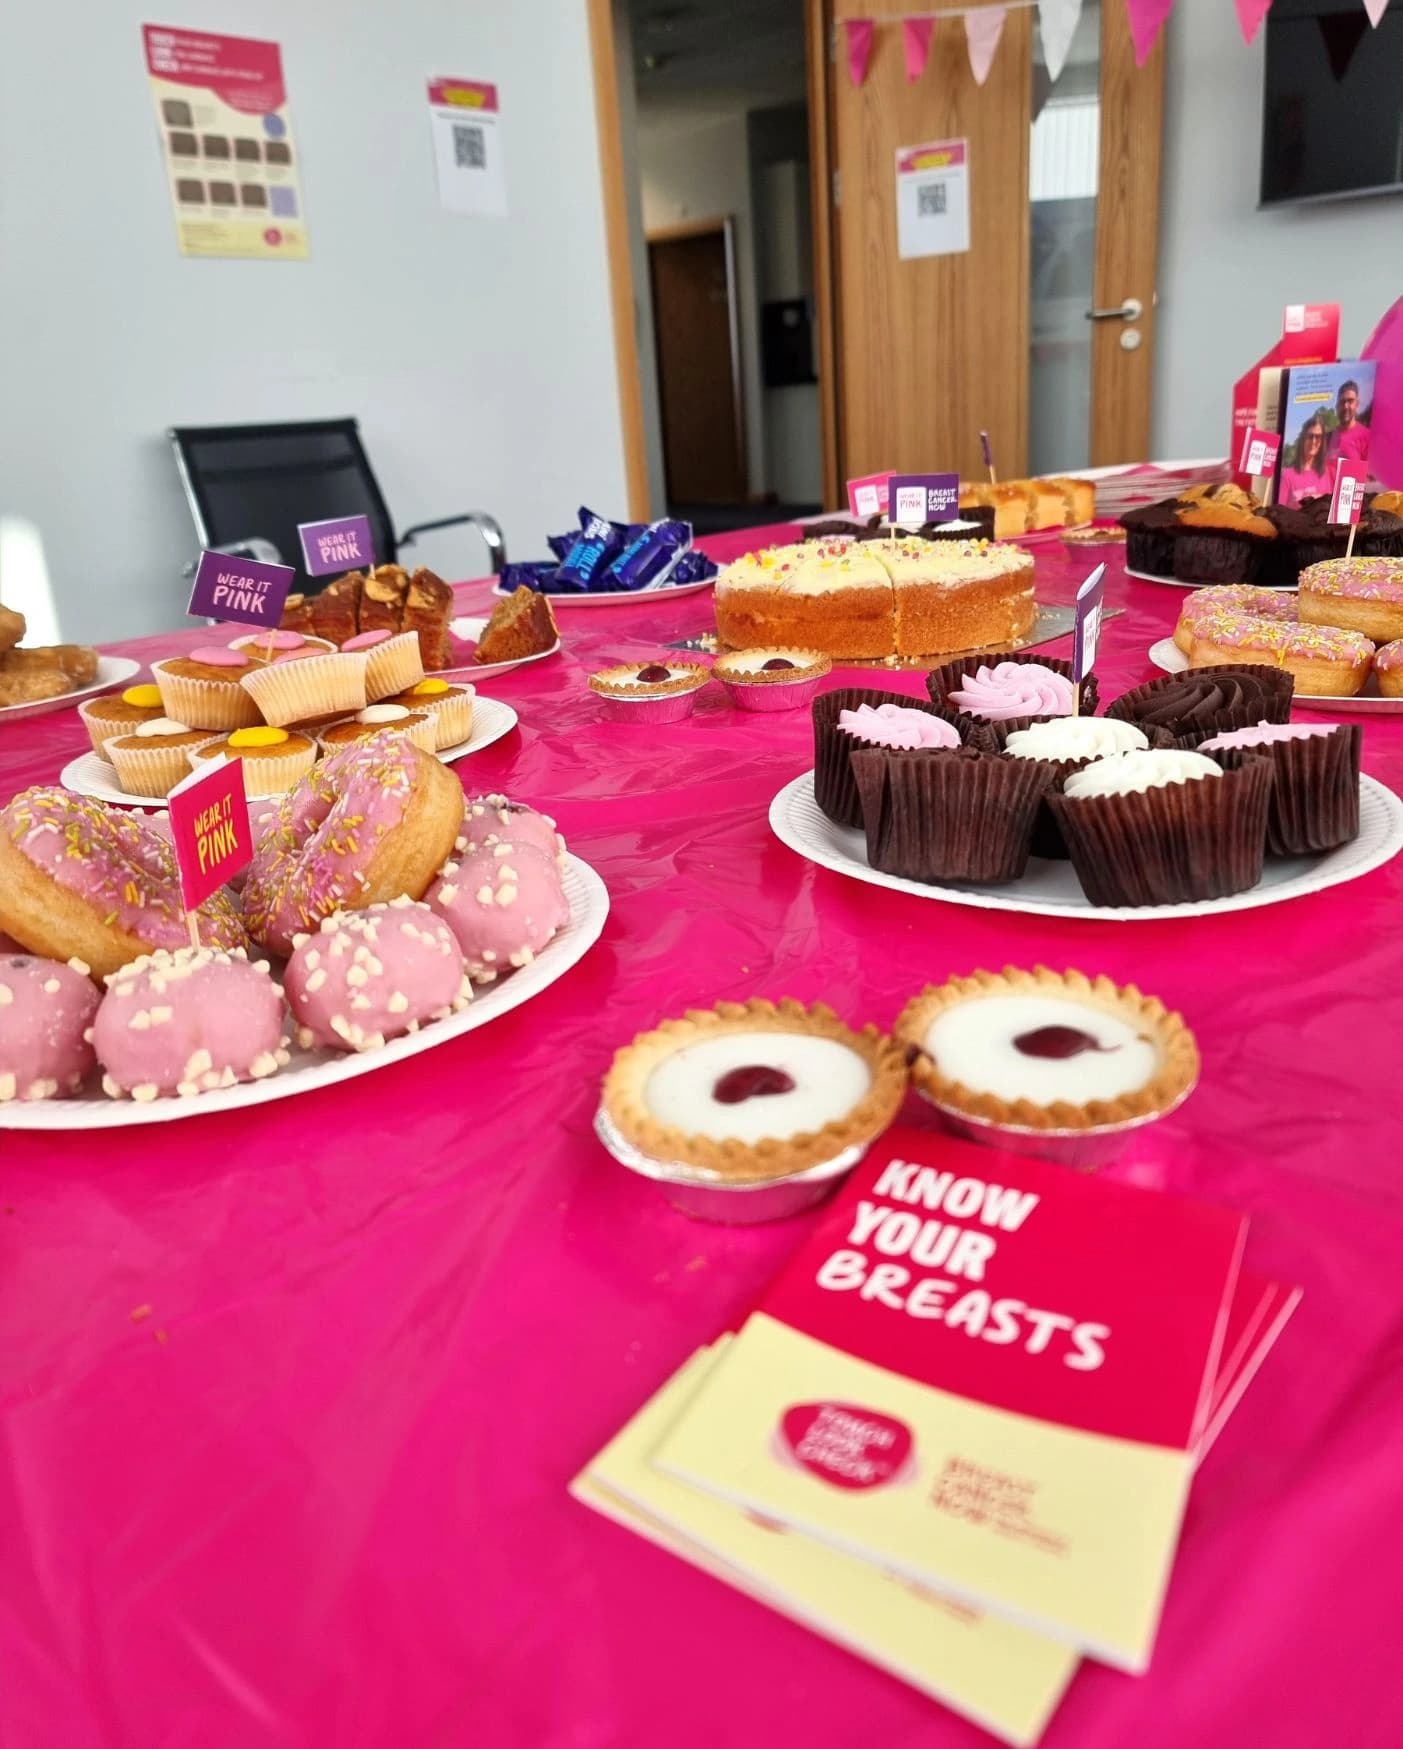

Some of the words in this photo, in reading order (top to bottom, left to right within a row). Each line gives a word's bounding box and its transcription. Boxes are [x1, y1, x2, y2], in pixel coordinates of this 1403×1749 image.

[899, 500, 923, 509] PINK
[928, 488, 957, 497] BREAST
[928, 504, 947, 512] NOW
[317, 533, 345, 547] WEAR
[346, 531, 357, 542] IT
[319, 543, 362, 564] PINK
[216, 572, 255, 592] WEAR
[256, 580, 273, 593] IT
[212, 585, 267, 614] PINK
[194, 801, 222, 838] WEAR
[222, 792, 233, 817] IT
[196, 818, 239, 876] PINK
[872, 1159, 1041, 1232] KNOW
[846, 1200, 997, 1283] YOUR
[815, 1248, 1112, 1372] BREASTS
